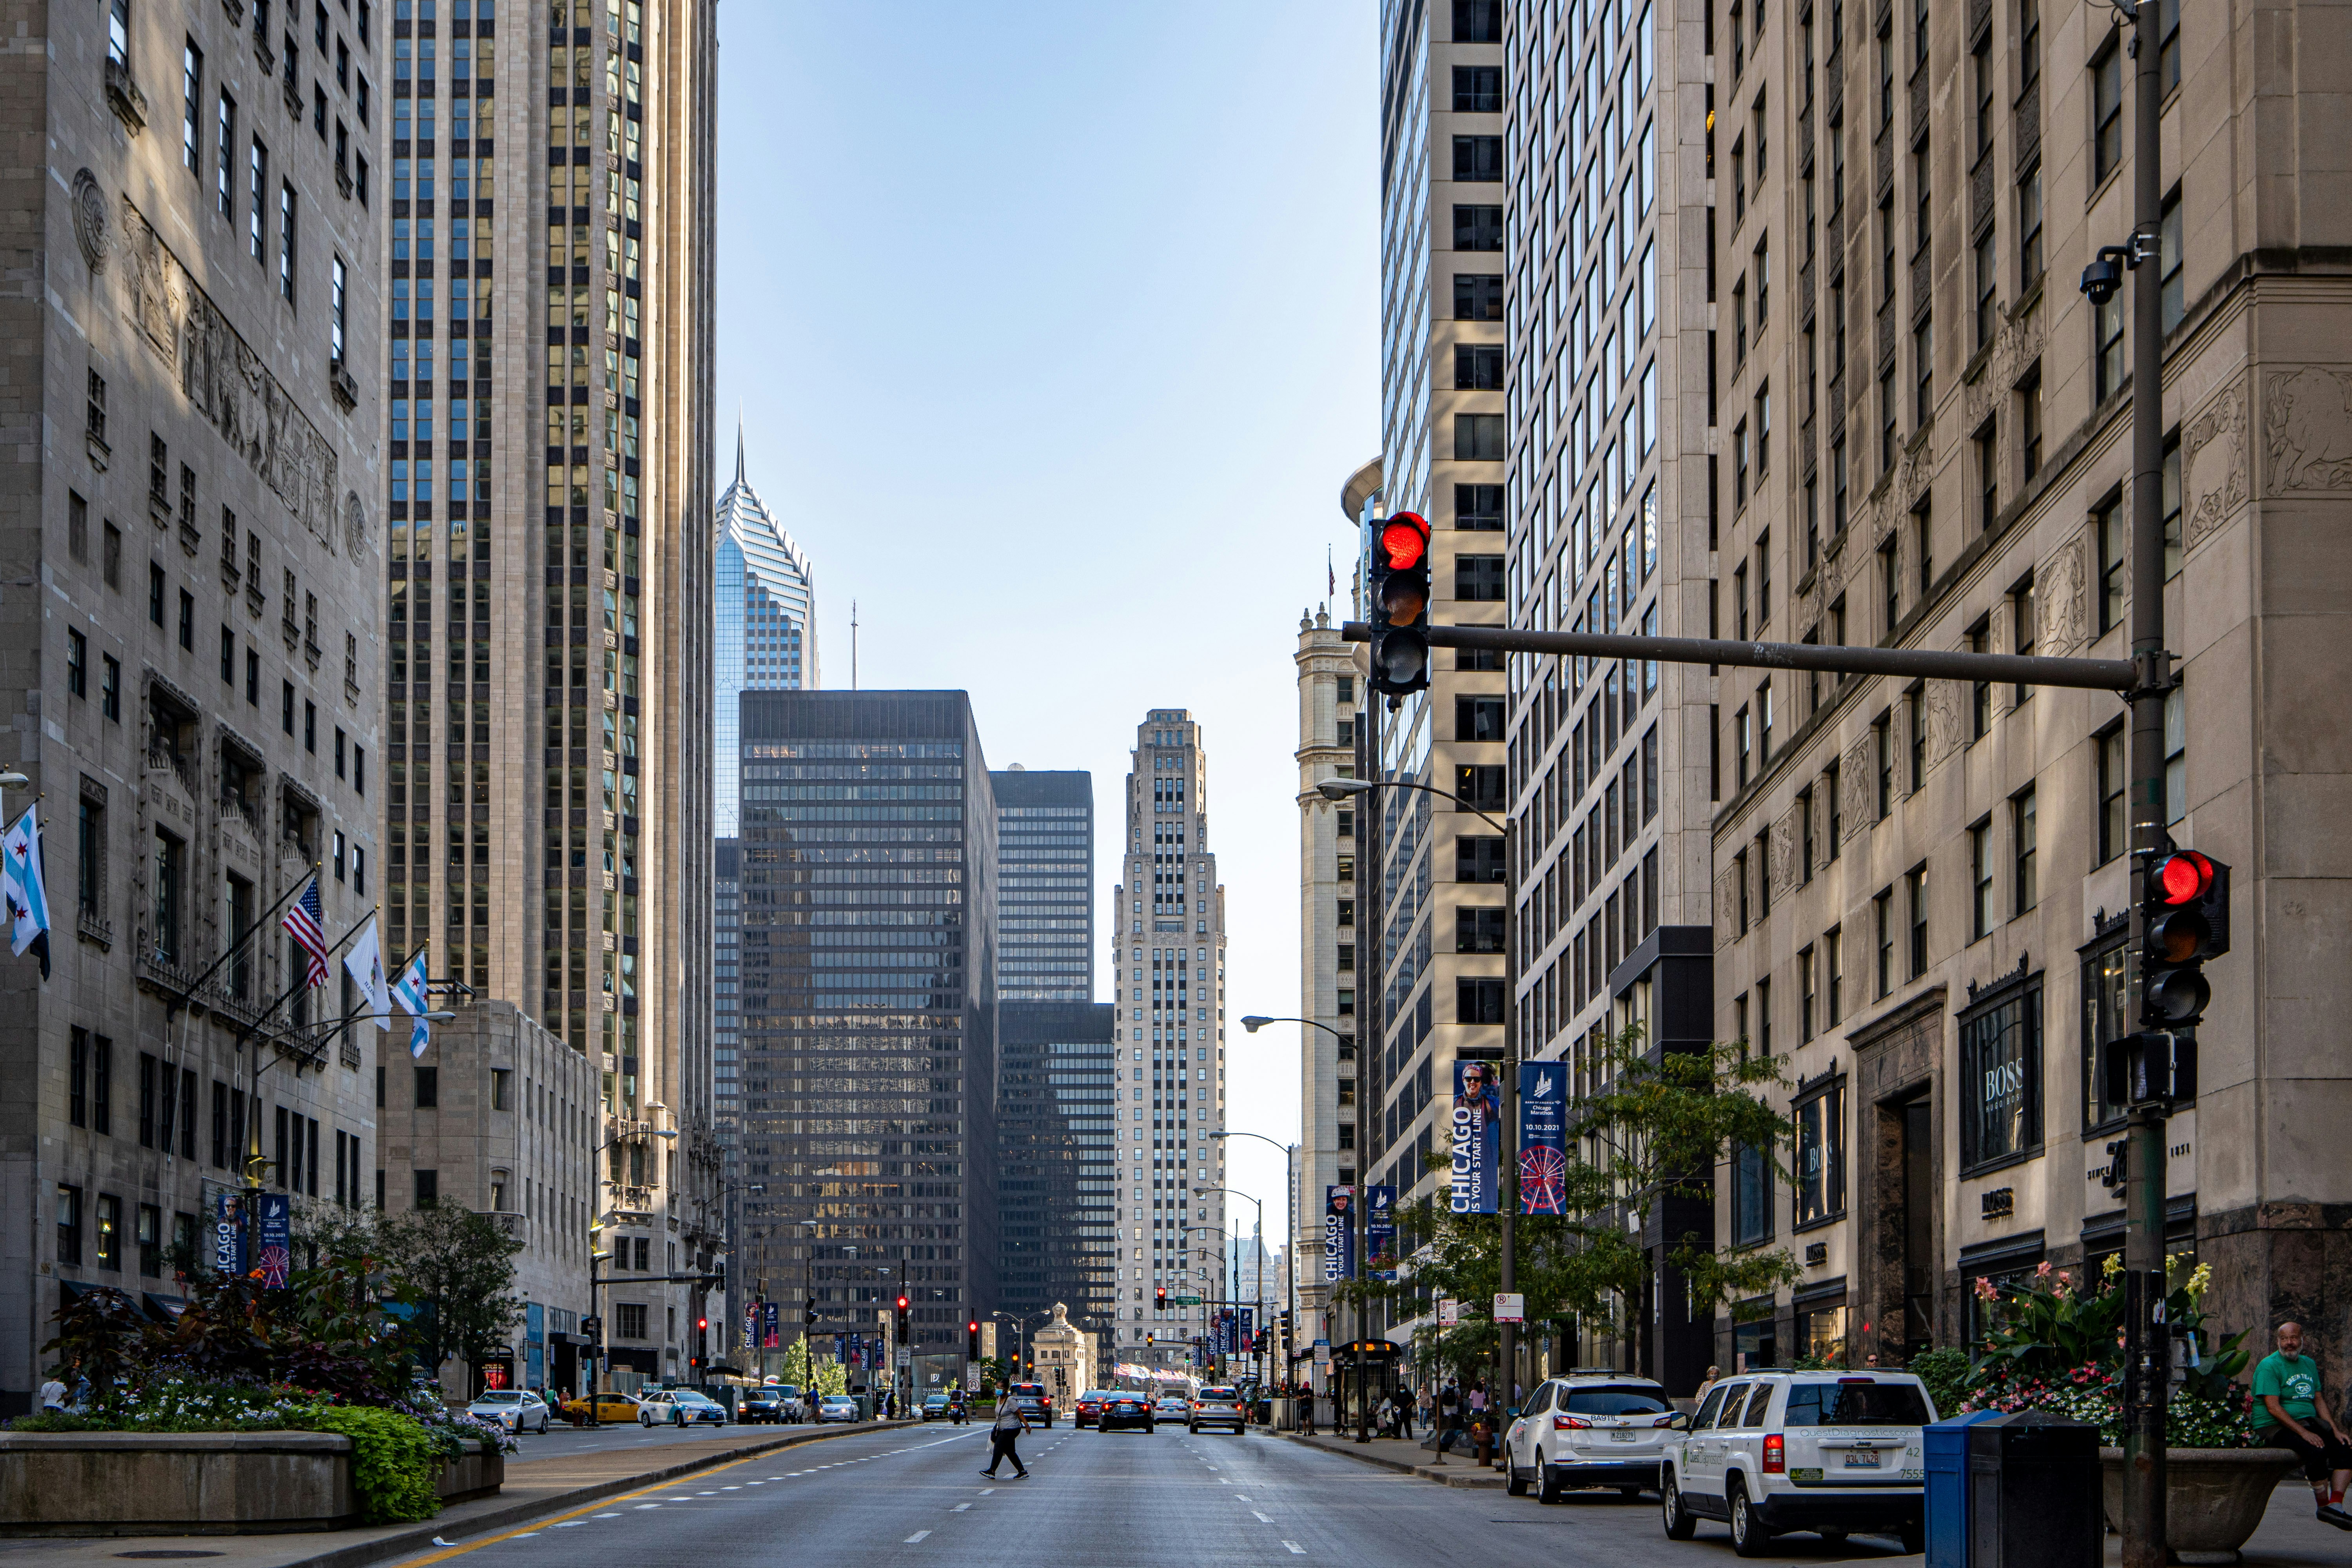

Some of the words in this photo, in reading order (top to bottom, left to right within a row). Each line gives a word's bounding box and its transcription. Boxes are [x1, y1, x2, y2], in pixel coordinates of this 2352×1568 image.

[1986, 1058, 2022, 1101] BOSS
[1986, 1100, 2002, 1113] HUGO
[1473, 1109, 1481, 1132] LINE
[1472, 1136, 1481, 1168] START
[2171, 1143, 2190, 1157] 1851
[1451, 1107, 1471, 1212] CHICAGO
[2087, 1166, 2110, 1180] SINCE
[1472, 1172, 1481, 1200] YOUR
[1472, 1203, 1480, 1212] IS
[218, 1223, 230, 1273] ICAGO
[1326, 1215, 1337, 1281] CHICAGO
[2286, 1374, 2301, 1386] GREEN
[1800, 1428, 1916, 1437] QuestDiagnostics.com
[1690, 1452, 1722, 1466] QuestDiagnostics
[1846, 1455, 1858, 1463] Q34
[1862, 1455, 1878, 1463] 7428
[1906, 1448, 1919, 1457] 42
[1901, 1469, 1924, 1479] 7555
